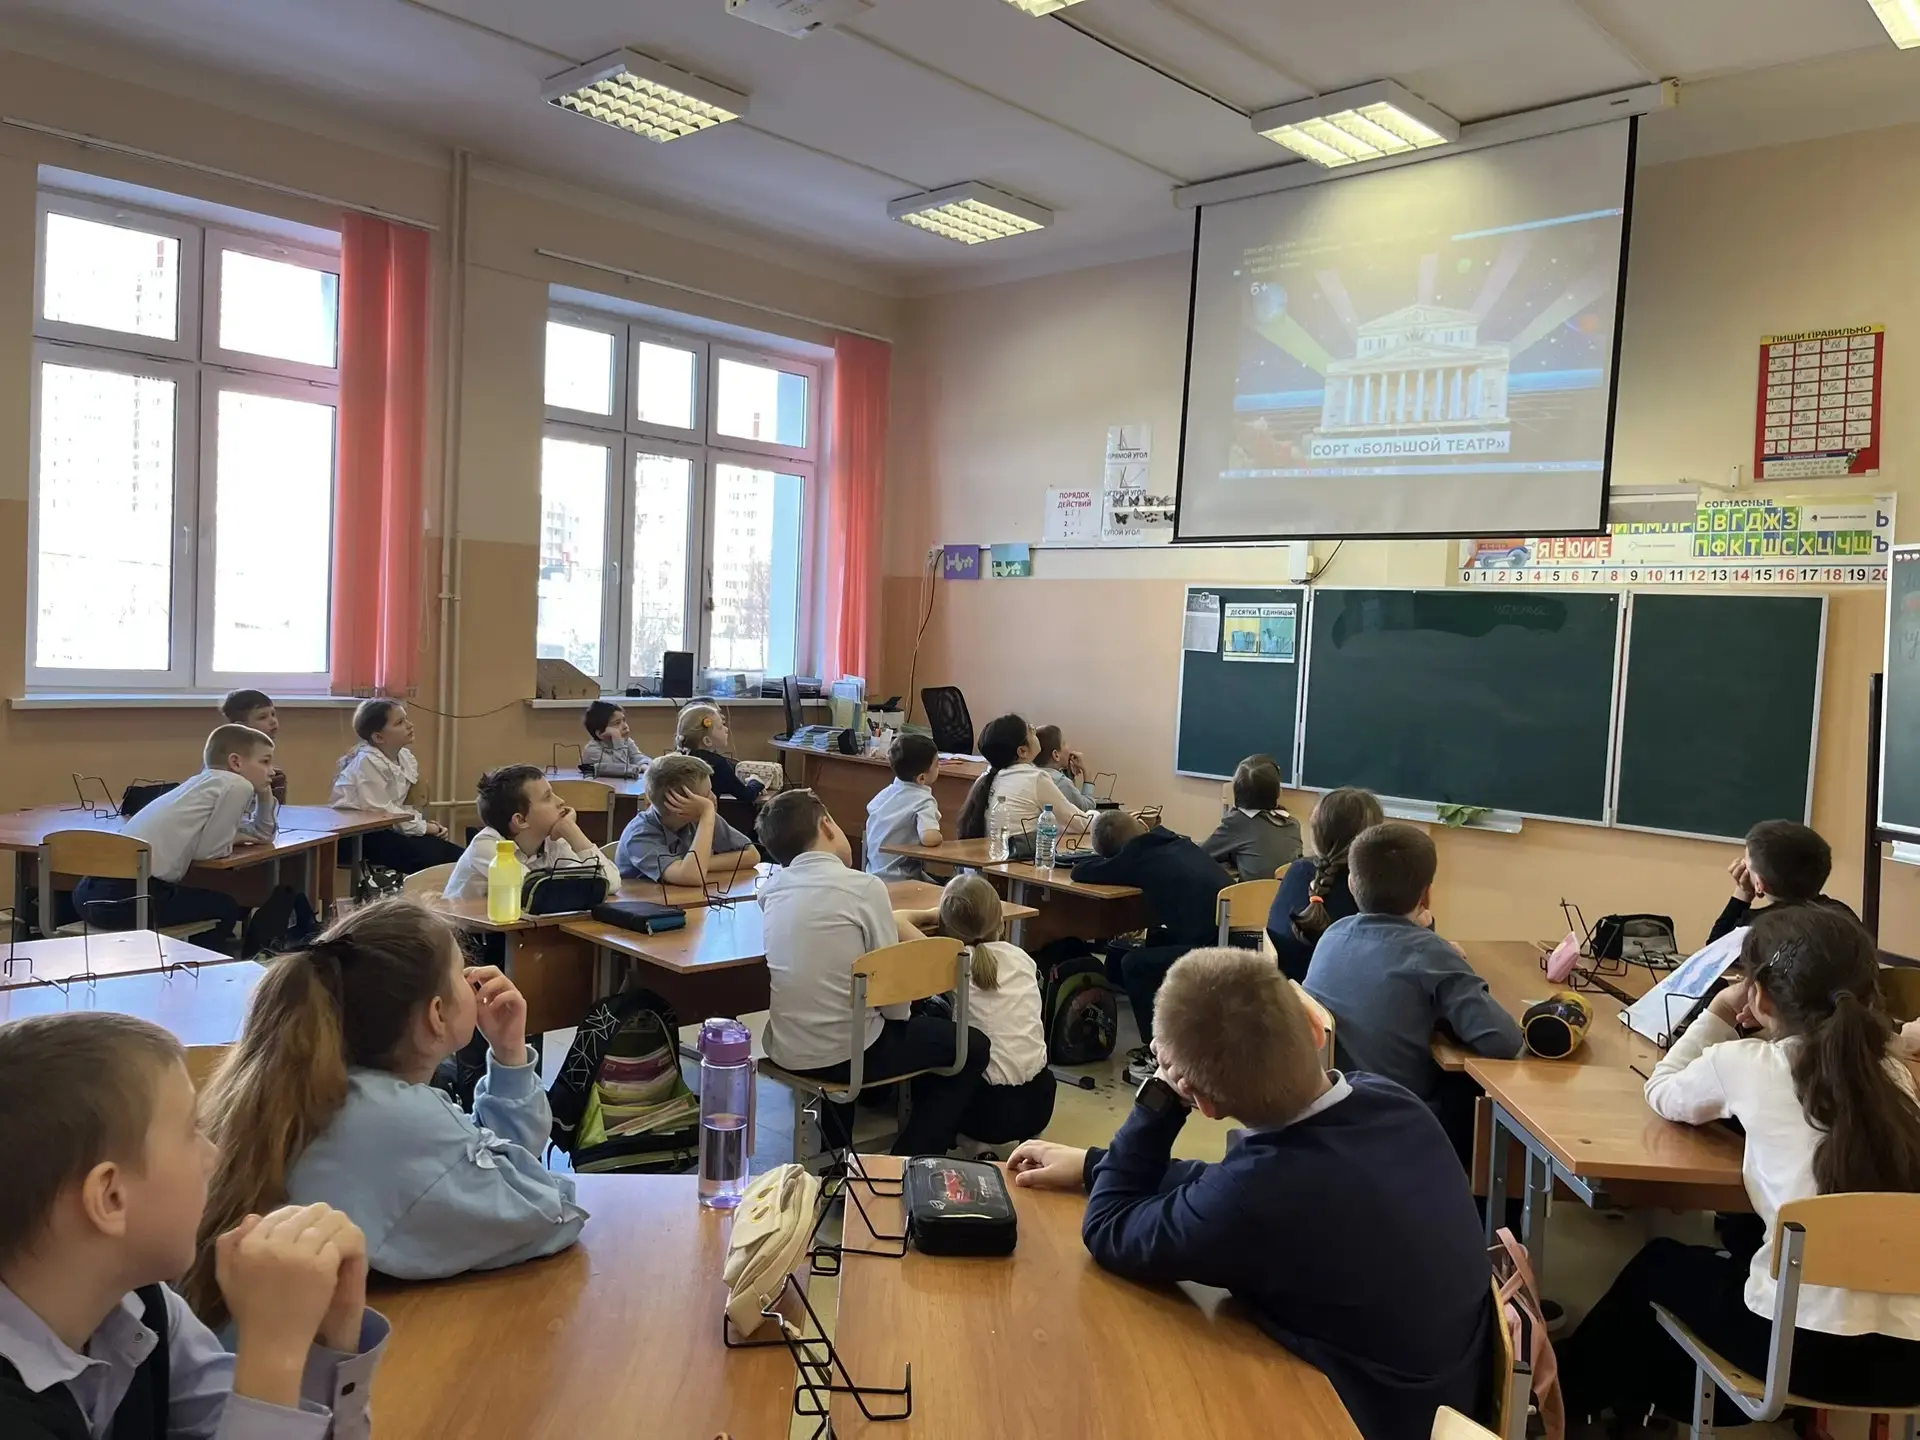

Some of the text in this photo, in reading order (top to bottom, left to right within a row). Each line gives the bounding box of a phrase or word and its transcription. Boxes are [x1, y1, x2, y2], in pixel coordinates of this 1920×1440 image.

[1250, 282, 1267, 296] 6+
[1772, 325, 1872, 343] ПИШИ ПРАВИЛЬНО
[1312, 437, 1505, 456] СОРТ «БОЛЬШОЙ ТЕАТР»
[1057, 499, 1092, 508] ДЕЙСТВИЙ
[1124, 528, 1141, 536] УГОЛ
[1464, 571, 1471, 582] 0
[1481, 571, 1487, 582] 1
[1498, 571, 1506, 582] 2
[1515, 571, 1523, 581] 3
[1534, 571, 1541, 581] 4
[1552, 571, 1560, 581] 5
[1572, 571, 1579, 581] 6
[1591, 571, 1599, 581] 7
[1610, 570, 1618, 581] 8
[1630, 570, 1638, 581] 9
[1648, 570, 1663, 581] 10
[1669, 570, 1683, 581] 11
[1689, 570, 1705, 581] 12
[1711, 570, 1727, 581] 13
[1733, 570, 1750, 580] 14
[1755, 569, 1772, 580] 15
[1778, 569, 1795, 580] 16
[1800, 569, 1818, 580] 17
[1824, 569, 1841, 580] 18
[1848, 569, 1866, 580] 19
